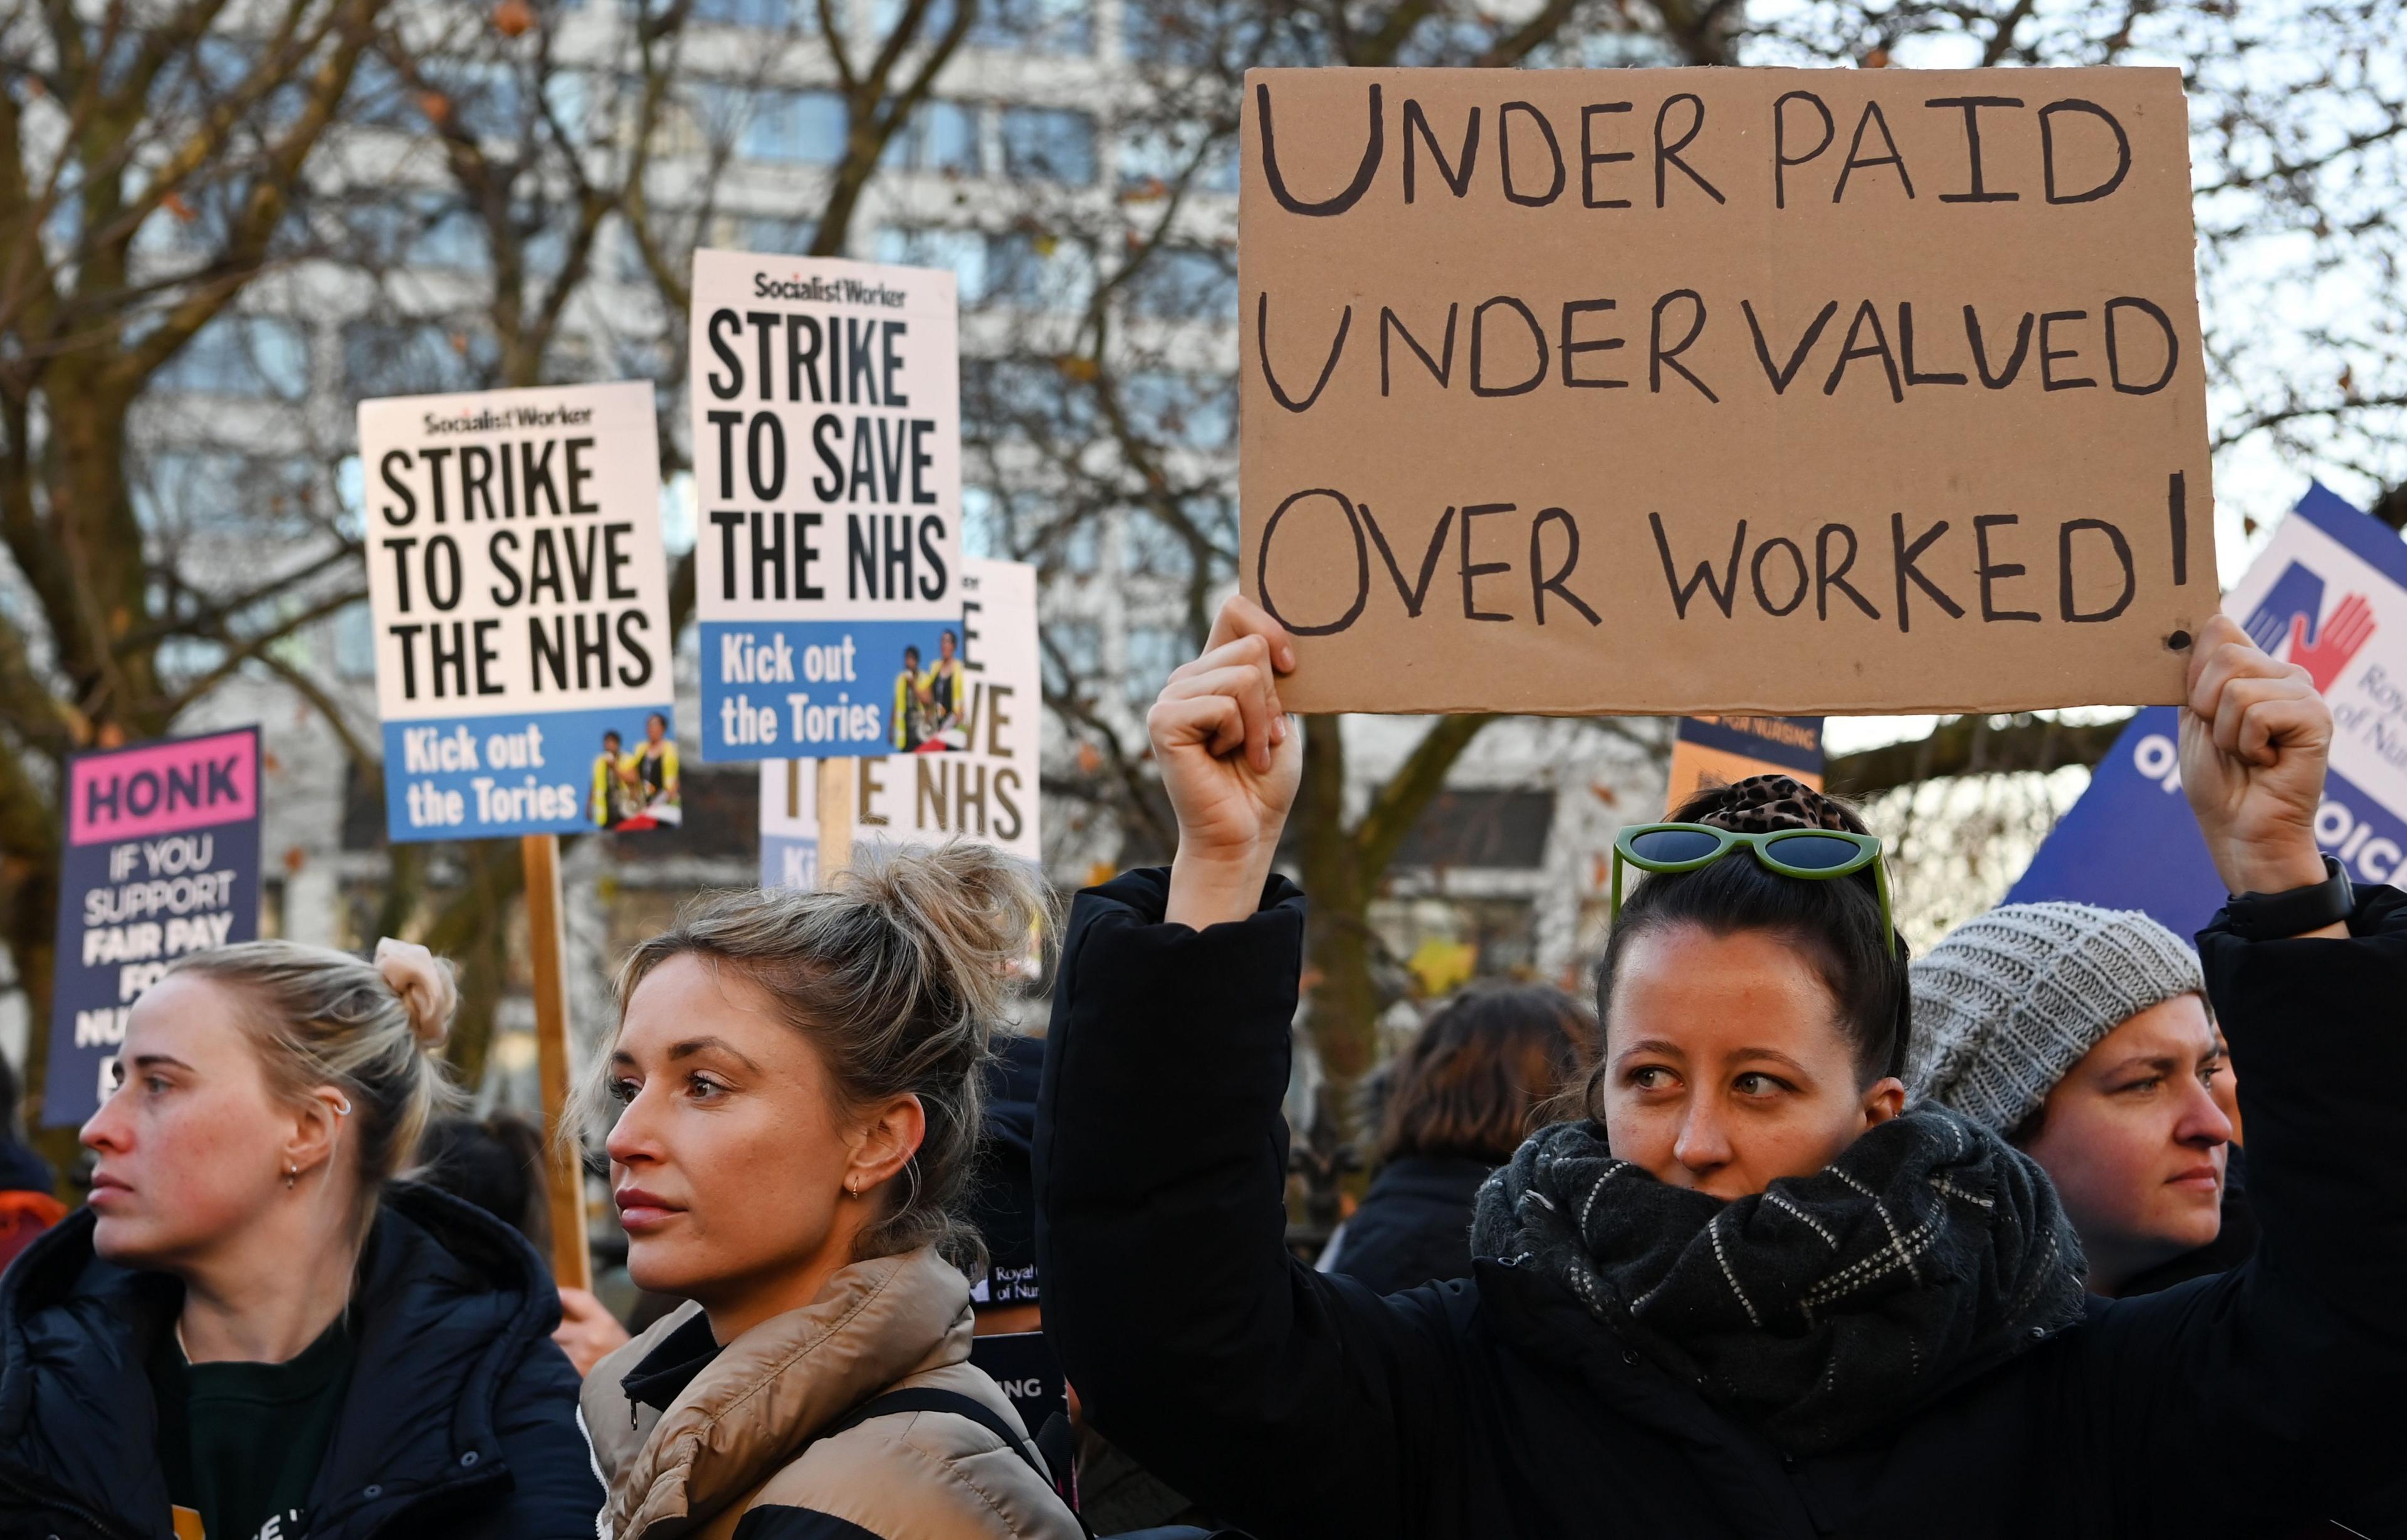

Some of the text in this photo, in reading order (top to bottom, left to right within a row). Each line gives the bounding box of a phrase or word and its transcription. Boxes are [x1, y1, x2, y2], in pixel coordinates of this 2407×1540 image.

[1257, 83, 2131, 216] UNDER PAID
[708, 308, 909, 407] STRIKE
[380, 437, 599, 527] STRIKE
[707, 410, 938, 505] TO SAVE
[383, 523, 637, 612] TO SAVE
[710, 511, 948, 602] THE NHS
[1257, 470, 2191, 651] OVER WORKED!
[389, 609, 652, 700] THE NHS
[721, 633, 857, 684] Kick out
[403, 723, 545, 774] Kick out
[720, 693, 881, 746] the Tories
[85, 755, 241, 824] HONK
[407, 775, 578, 828] the Tories
[915, 755, 1023, 842] NHS
[110, 833, 214, 881] IF YOU
[83, 869, 236, 927] SUPPORT
[82, 911, 235, 967] FAIR PAY
[118, 959, 178, 1003] FO
[995, 1263, 1034, 1282] Royal
[996, 1287, 1010, 1300] of
